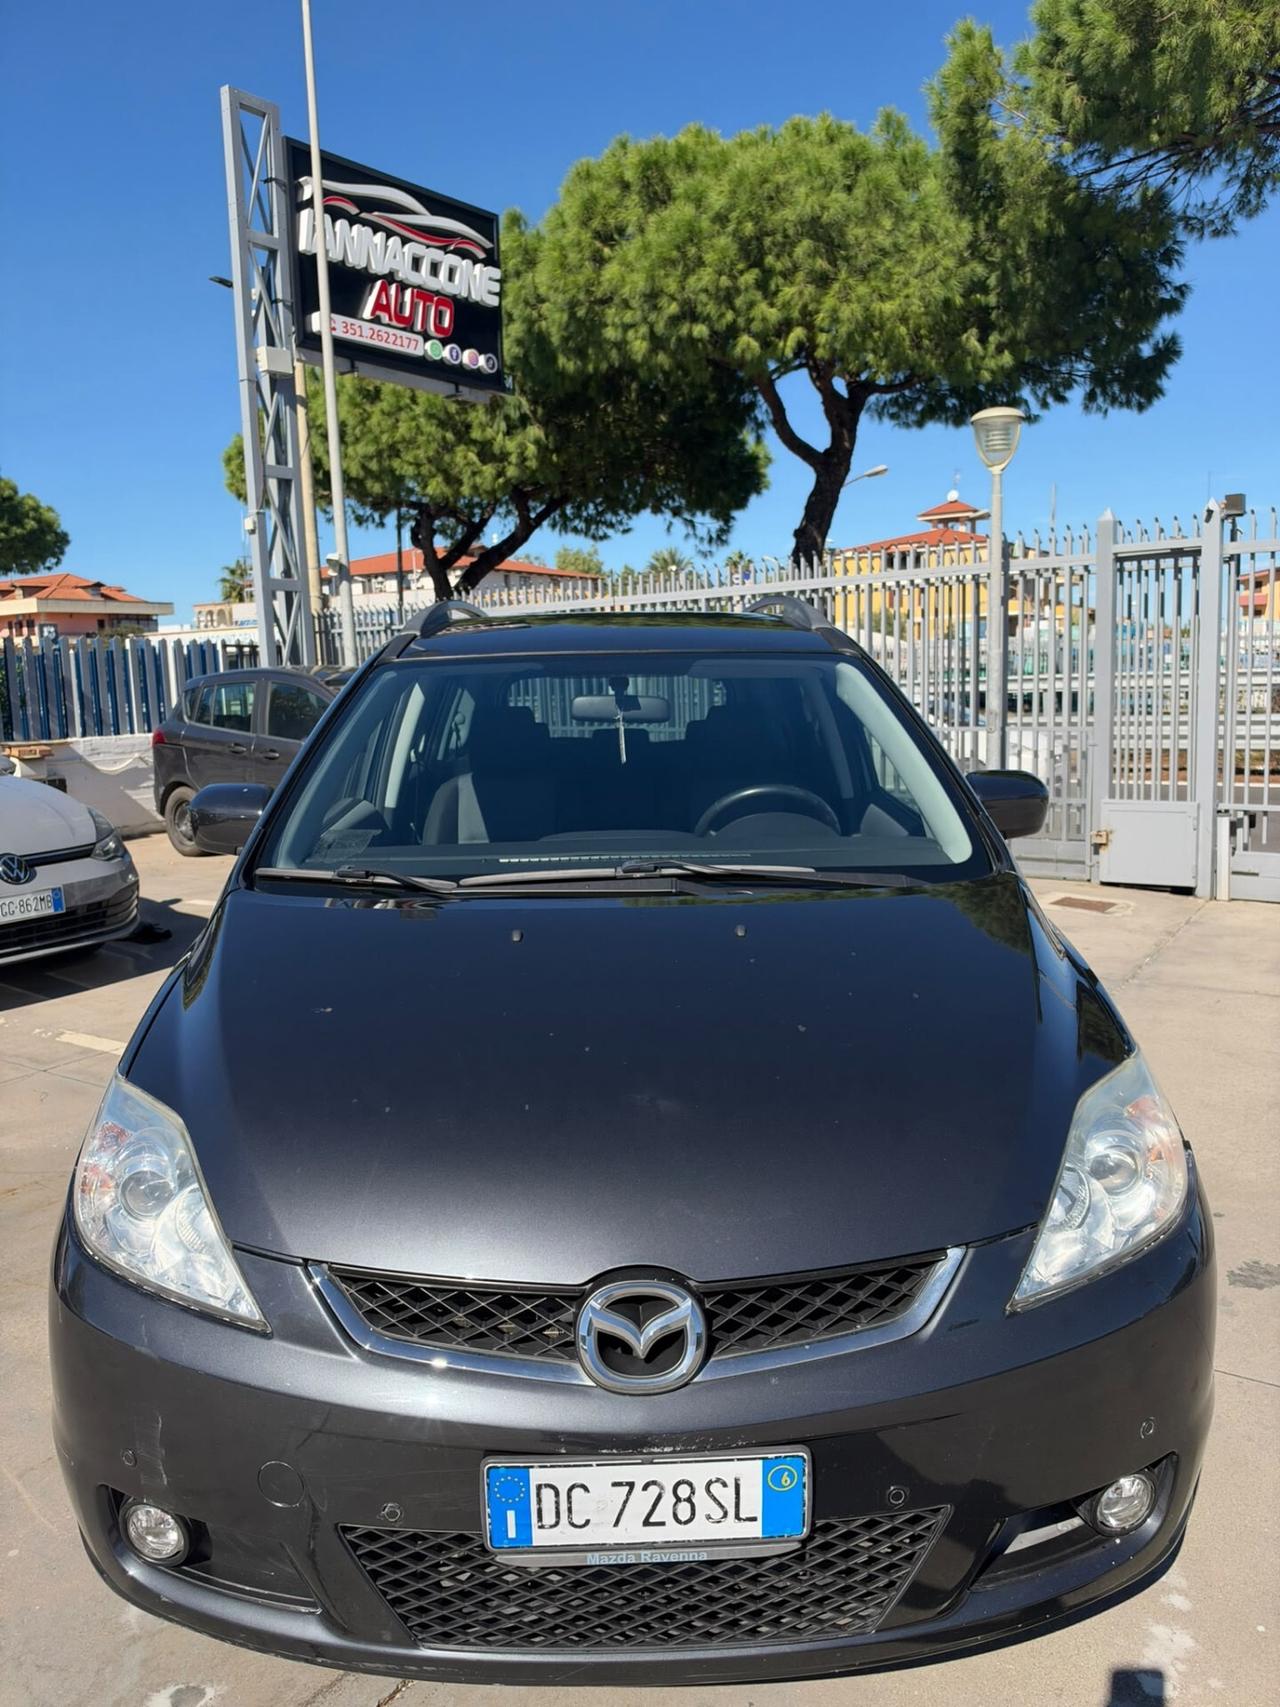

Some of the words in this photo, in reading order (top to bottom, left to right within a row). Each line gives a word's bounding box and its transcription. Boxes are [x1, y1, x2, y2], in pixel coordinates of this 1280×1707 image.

[298, 207, 502, 307] IANNACCONE
[341, 320, 419, 351] 351.2622177
[363, 279, 455, 338] AUTO
[535, 1481, 591, 1530] DC
[610, 1476, 758, 1529] 728SL
[586, 1552, 635, 1566] Mazda
[641, 1550, 708, 1563] Ravenna
